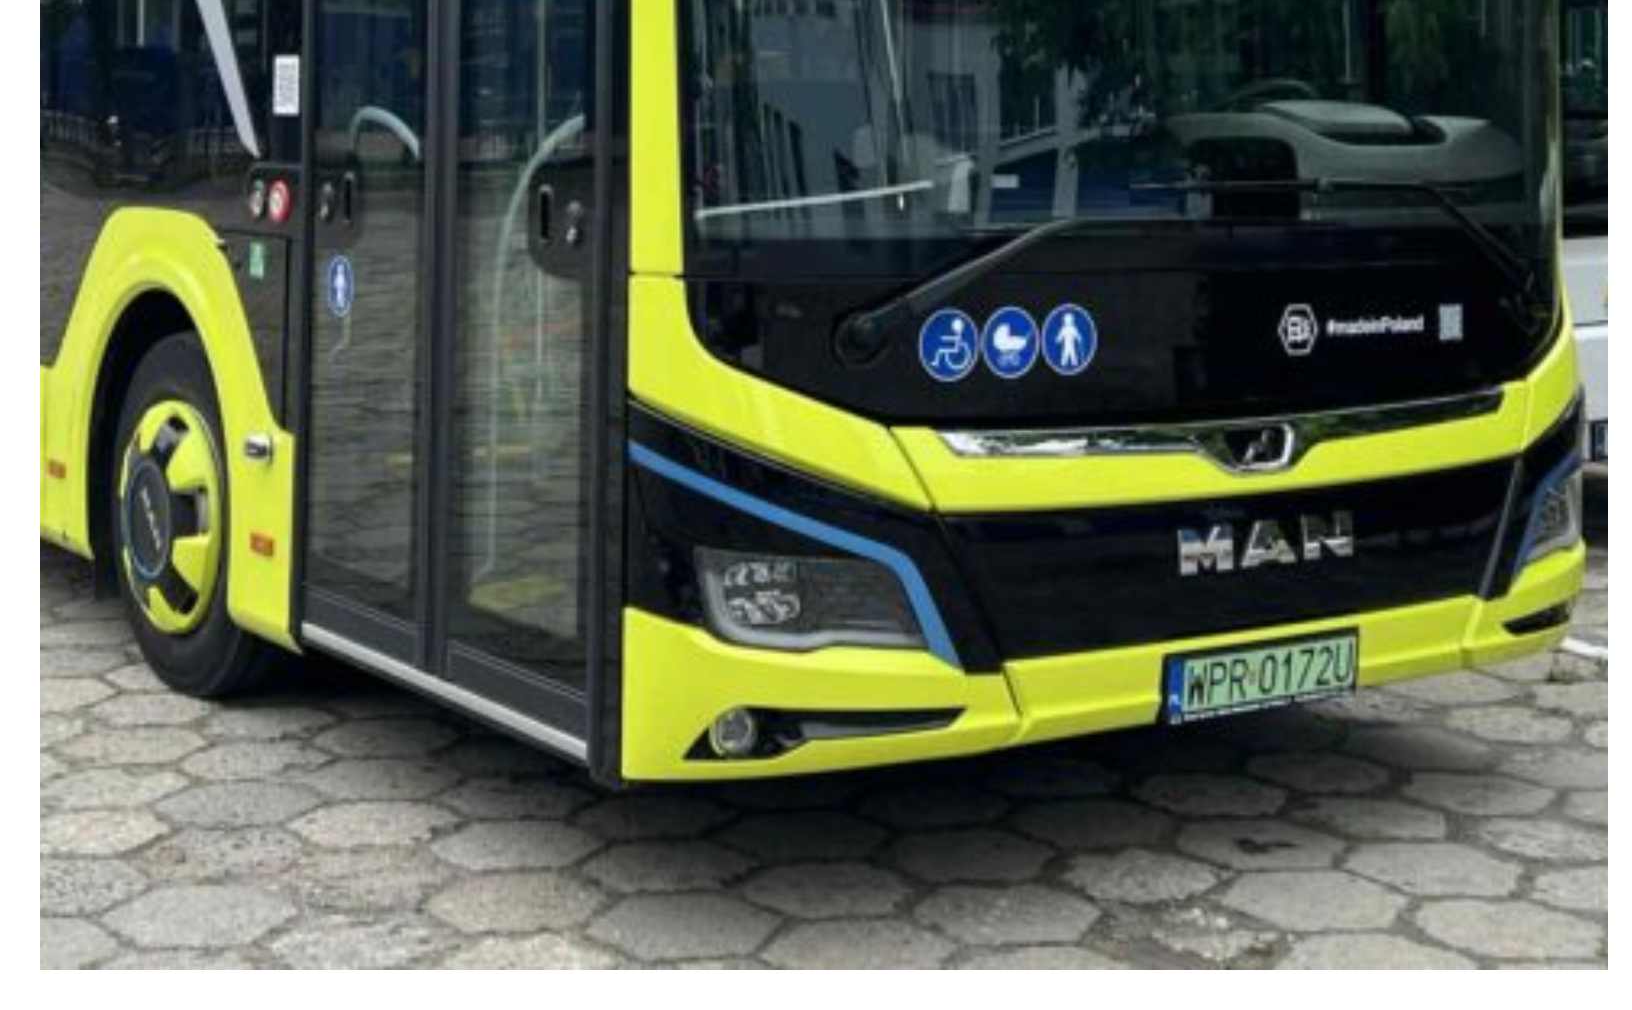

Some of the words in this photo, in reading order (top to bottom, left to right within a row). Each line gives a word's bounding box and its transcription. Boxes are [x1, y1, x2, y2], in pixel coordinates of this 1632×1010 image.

[1176, 509, 1354, 577] MAN
[1187, 658, 1249, 705] WPR
[1258, 640, 1353, 694] 0172U
